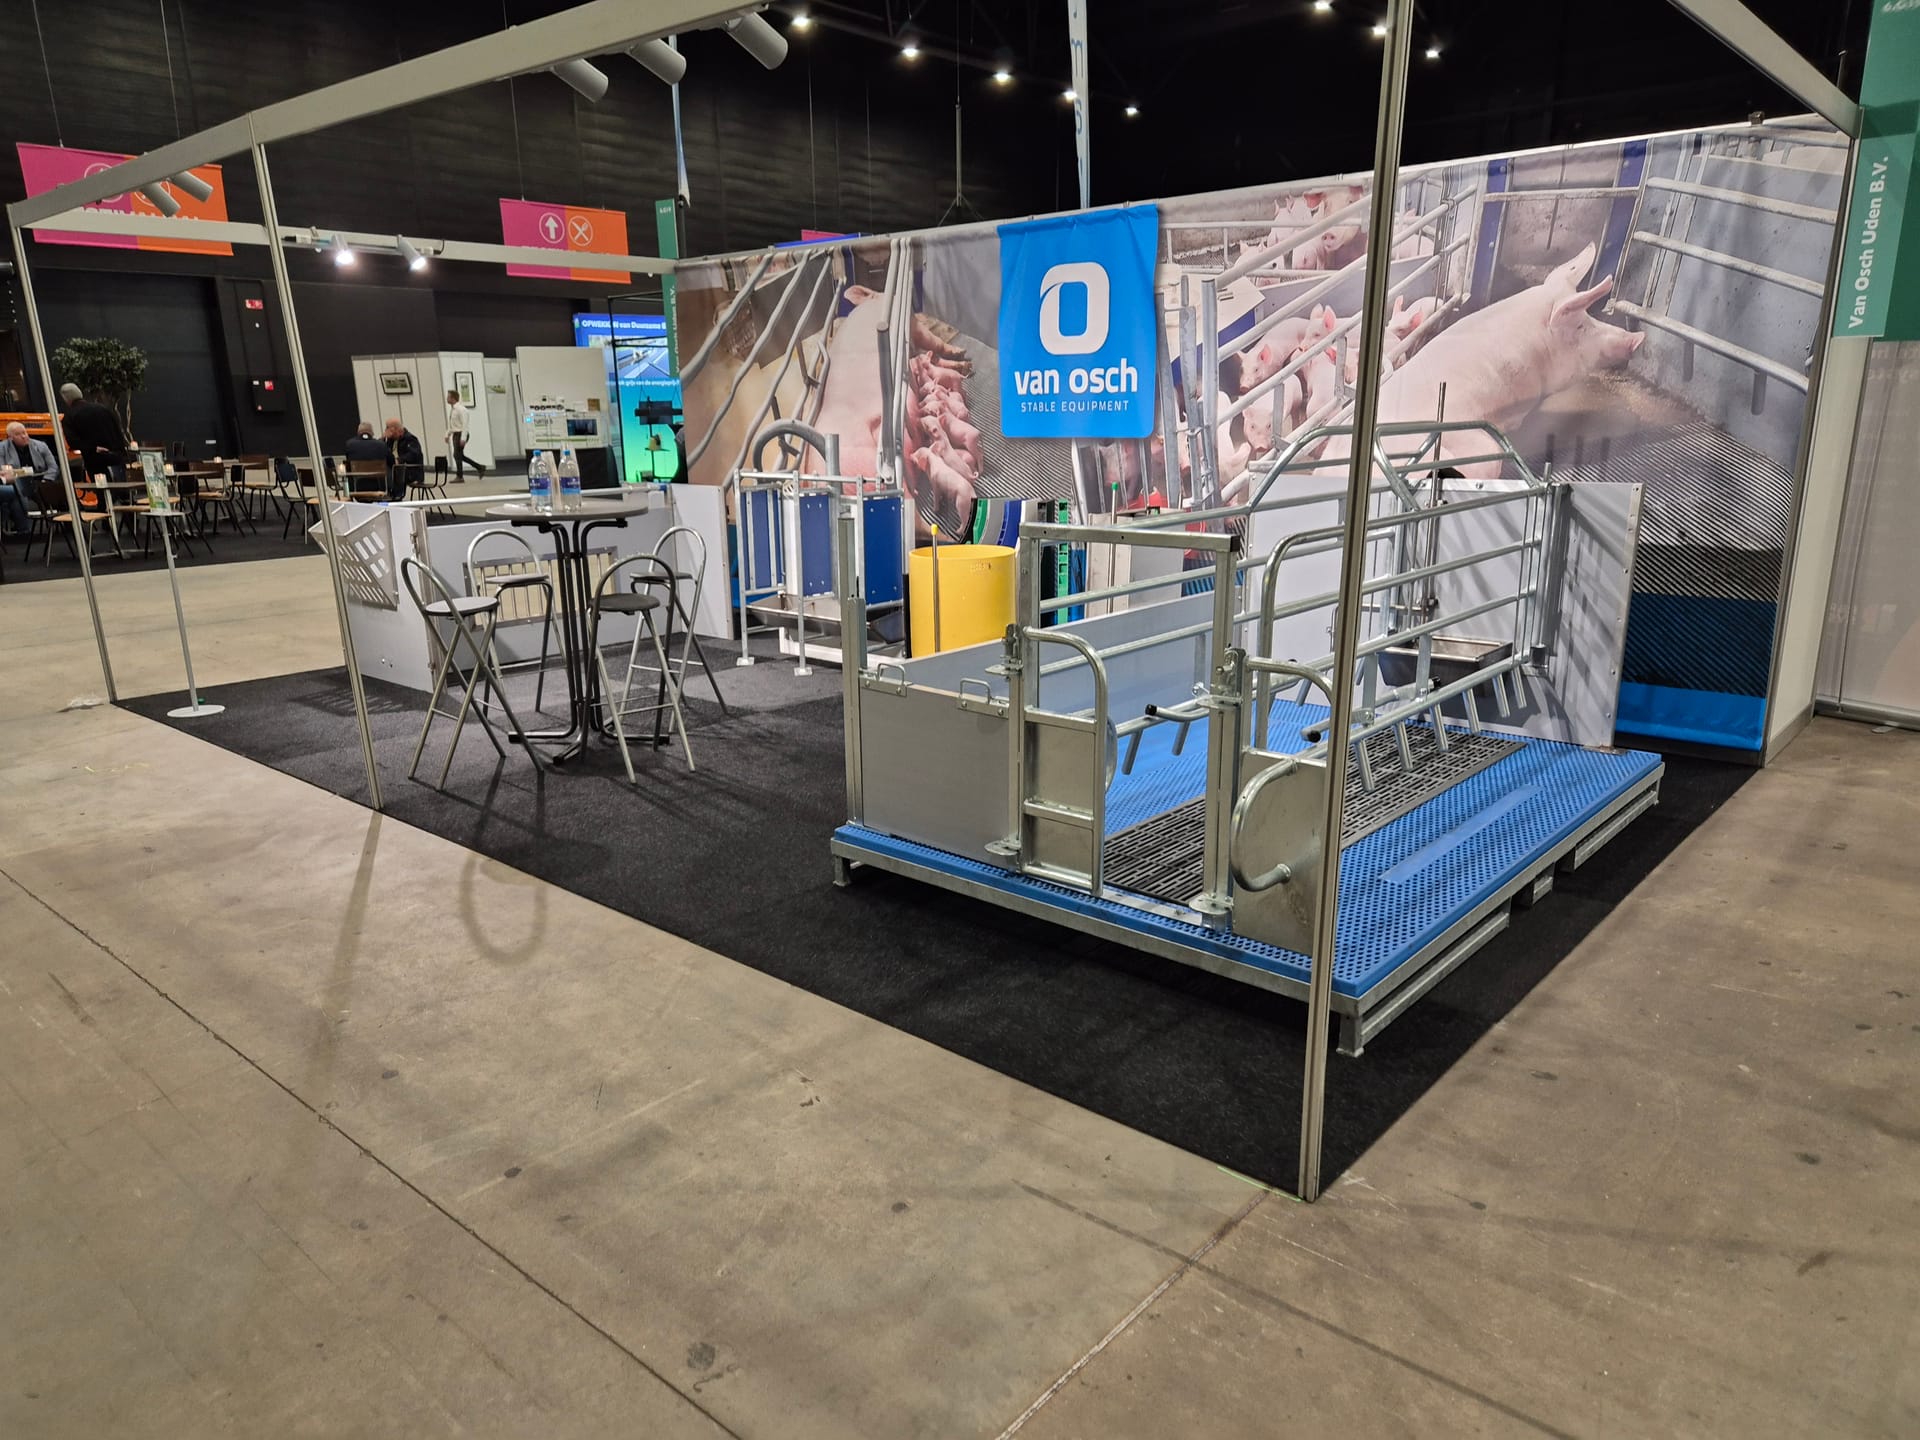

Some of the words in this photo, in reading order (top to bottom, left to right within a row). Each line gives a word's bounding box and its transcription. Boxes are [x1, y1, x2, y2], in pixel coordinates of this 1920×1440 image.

[1869, 156, 1889, 193] B.V.
[1861, 197, 1882, 245] Uden
[1854, 249, 1874, 290] Osch
[1848, 295, 1867, 329] Van
[1014, 369, 1060, 395] van
[1069, 357, 1138, 394] osch
[1021, 401, 1056, 413] STABLE
[1061, 400, 1129, 413] EQUIPMENT
